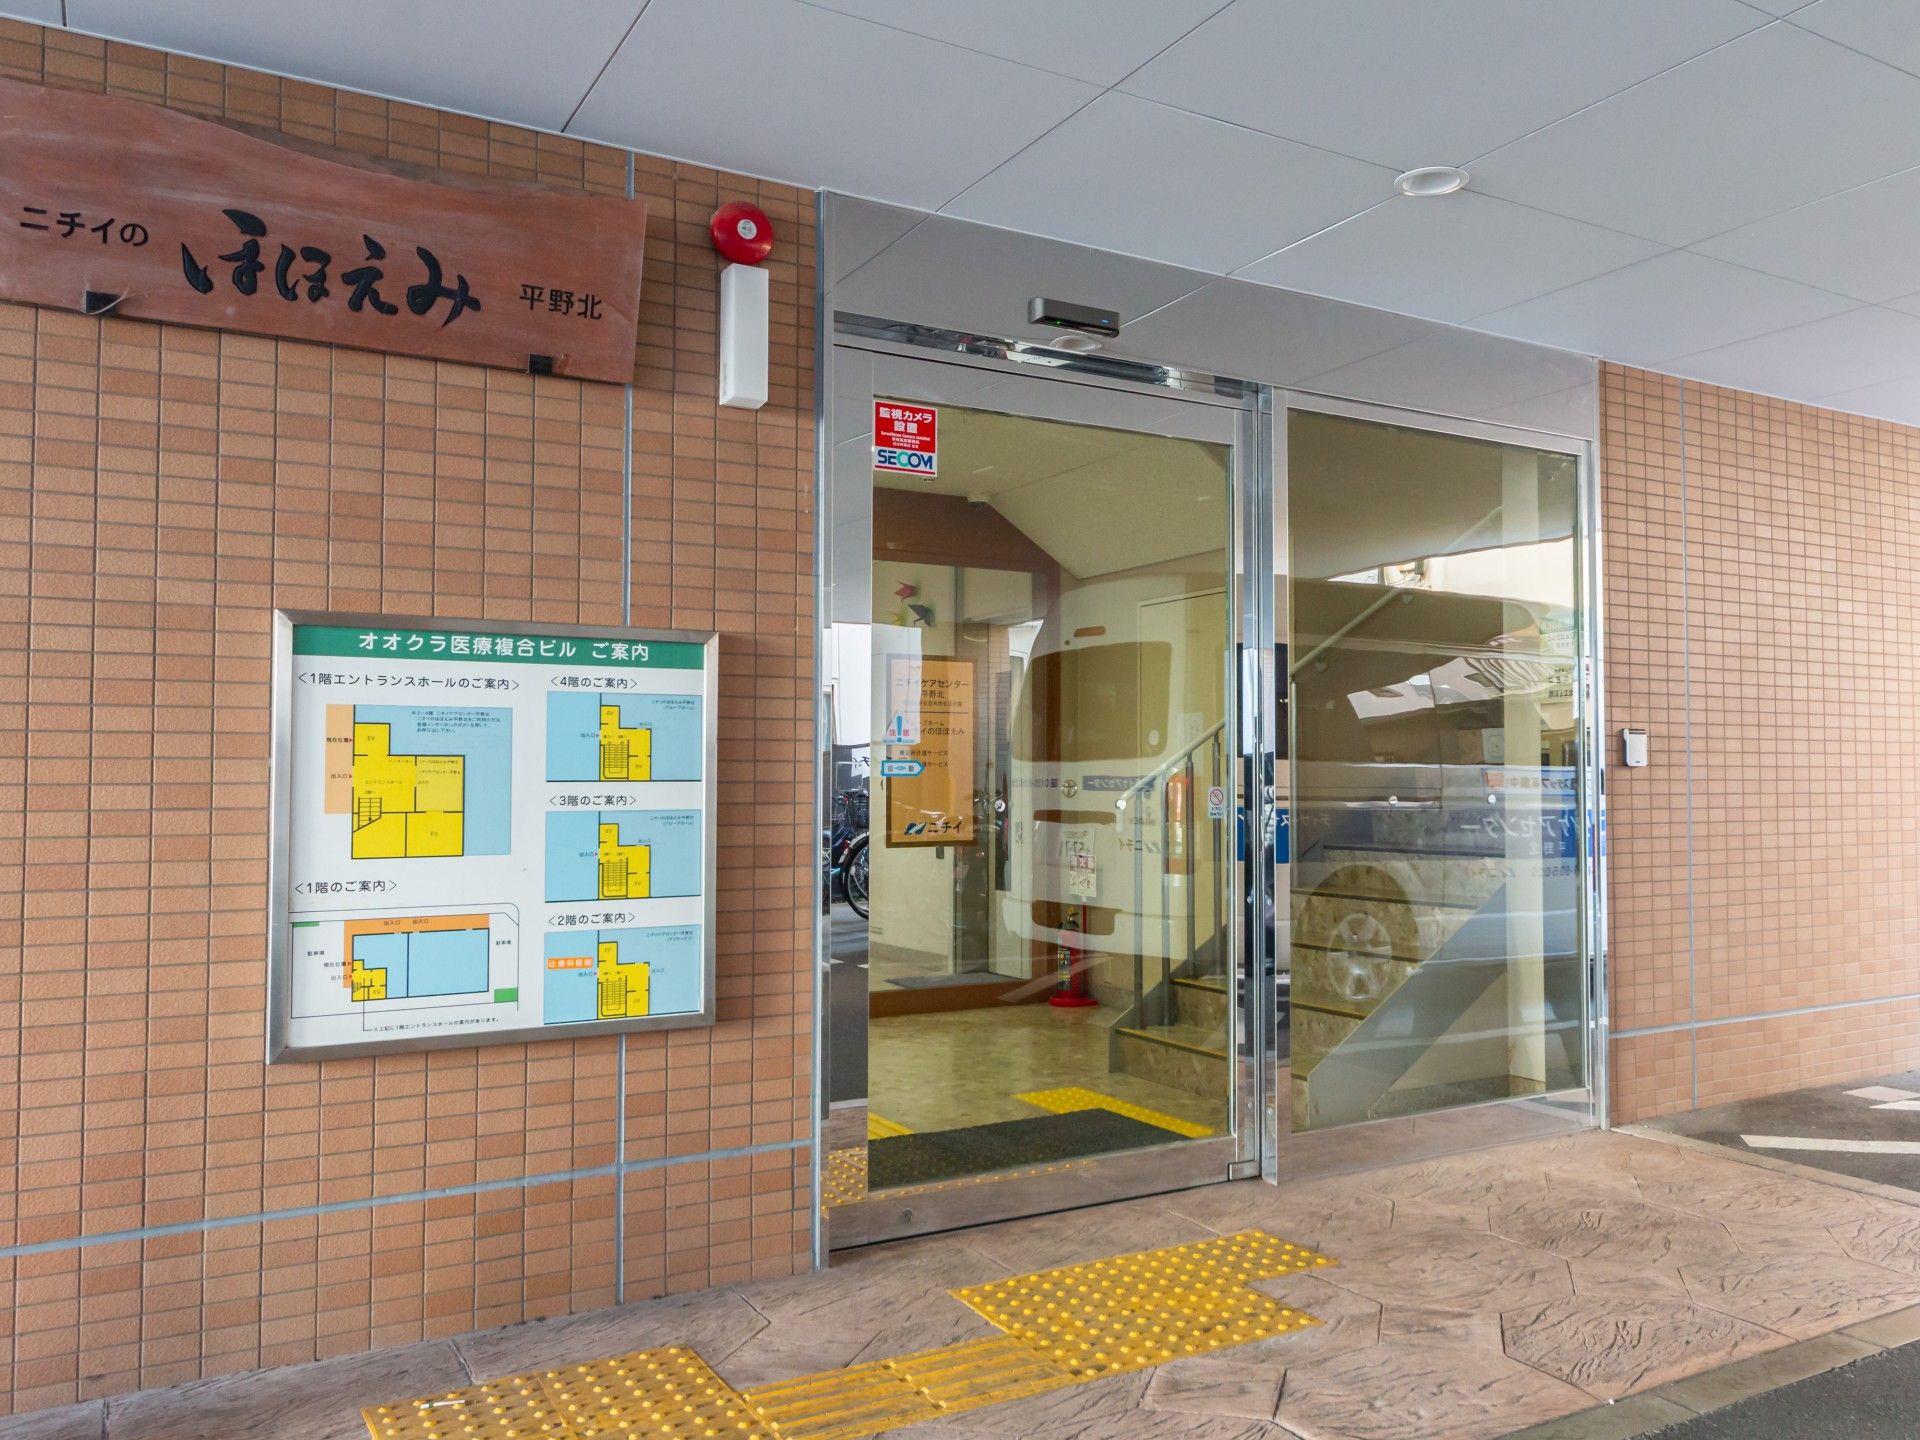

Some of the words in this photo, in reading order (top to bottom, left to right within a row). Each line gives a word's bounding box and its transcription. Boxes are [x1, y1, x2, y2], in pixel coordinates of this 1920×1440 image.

[19, 206, 149, 247] ニチイの
[181, 208, 482, 327] ほほえみ
[519, 282, 603, 320] 平野北
[879, 406, 932, 424] 監視カメラ
[894, 420, 918, 434] 設置
[878, 449, 932, 470] SECOM
[358, 631, 577, 660] オオクラ医療複合ビル
[591, 641, 650, 662] ご案内
[921, 690, 944, 698] 平野北
[928, 820, 962, 834] ニチイ
